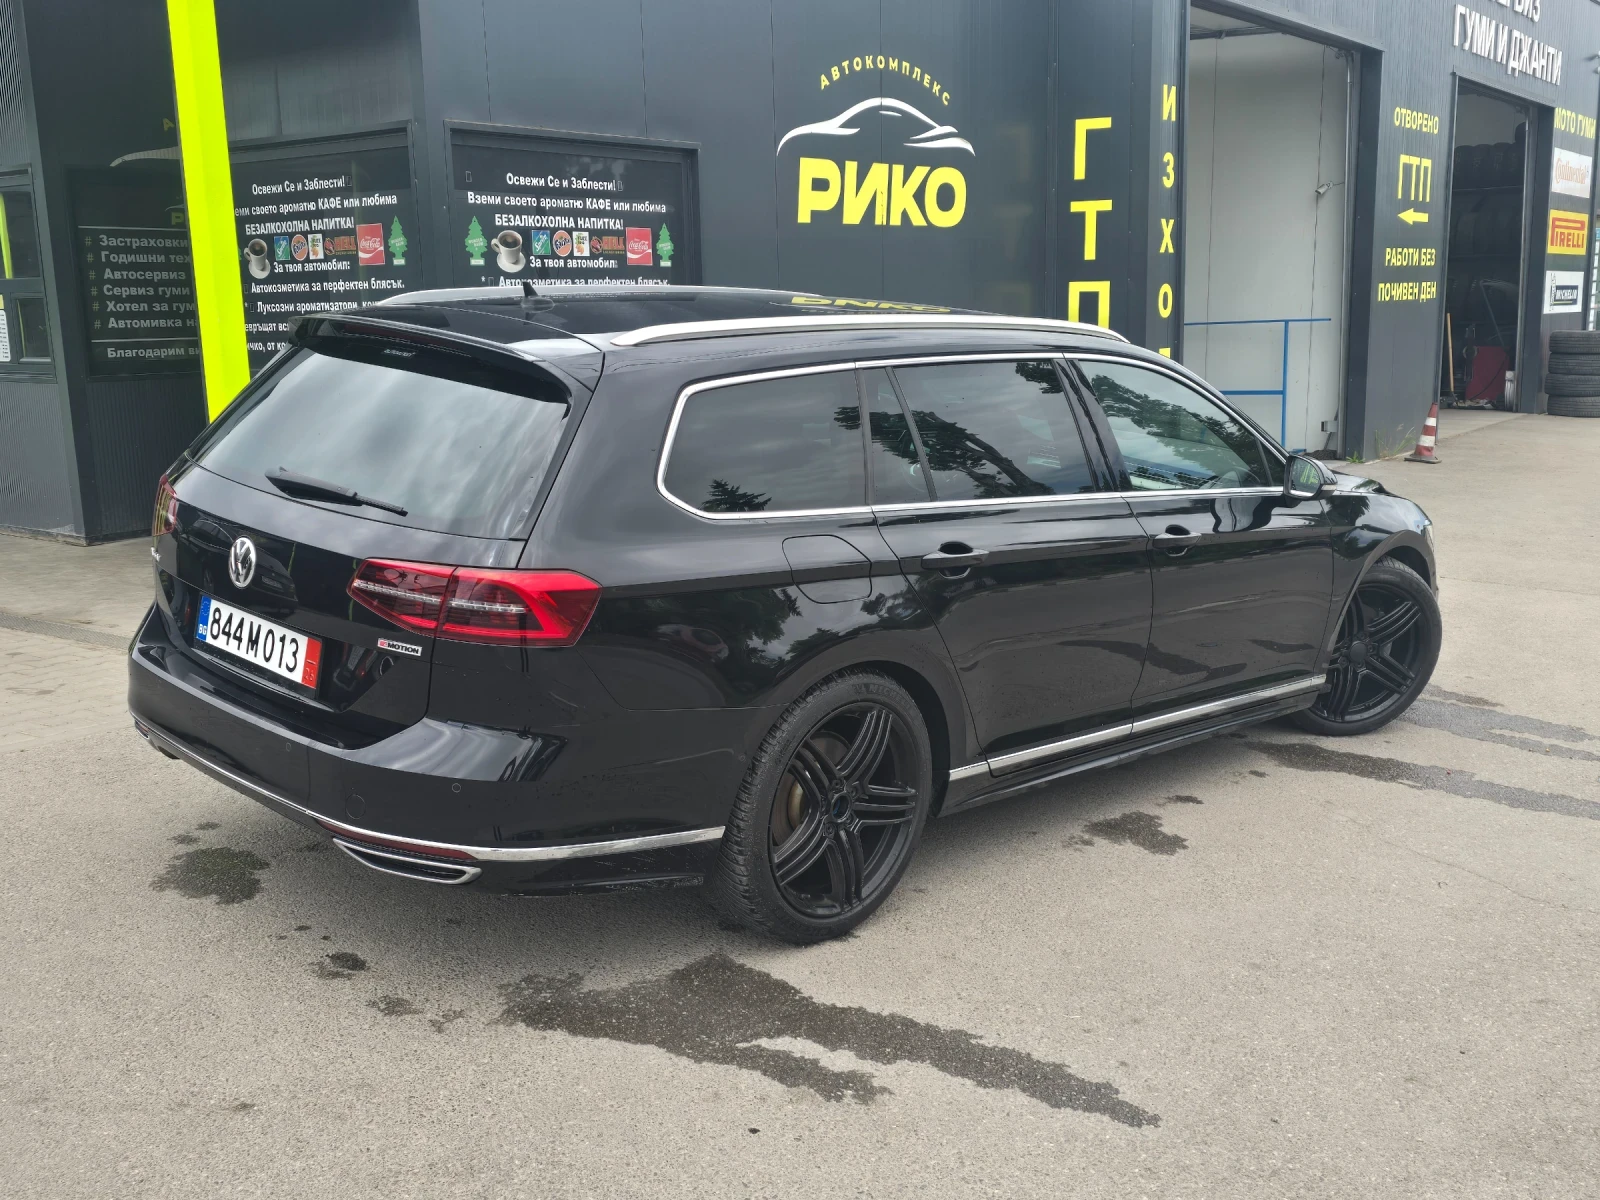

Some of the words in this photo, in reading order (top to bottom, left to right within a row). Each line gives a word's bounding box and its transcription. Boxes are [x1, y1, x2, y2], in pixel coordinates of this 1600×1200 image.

[1453, 4, 1496, 60] ГУМИ
[1496, 23, 1508, 65] И
[1507, 28, 1562, 86] ДЖАНТИ
[819, 55, 951, 106] АВТОКОМПЛЕКС
[1394, 106, 1439, 134] ОТВОРЕНО
[1554, 107, 1576, 134] МОТО
[1577, 113, 1596, 139] ГУМИ
[252, 182, 283, 195] Освежи
[284, 180, 295, 192] Се
[297, 182, 302, 191] и
[304, 175, 345, 190] Заблести!
[506, 172, 545, 186] Освежи
[547, 175, 560, 188] Се
[562, 179, 569, 188] и
[571, 177, 616, 191] Заблести!
[1398, 154, 1432, 202] ГТП
[797, 157, 967, 228] РИКО
[235, 206, 250, 217] еми
[252, 204, 277, 215] своето
[279, 201, 316, 215] ароматно
[318, 197, 342, 210] КАФЕ
[343, 199, 359, 208] или
[362, 193, 397, 207] любима
[467, 191, 501, 205] Вземи
[504, 195, 537, 206] своето
[540, 198, 583, 210] ароматно
[586, 198, 611, 211] КАФЕ
[613, 201, 630, 211] или
[632, 200, 666, 213] любима
[245, 218, 310, 235] БЕЗАЛКОХОЛНА
[311, 216, 354, 231] НАПИТКА!
[495, 213, 575, 229] БЕЗАЛКОХОЛНА
[577, 216, 624, 231] НАПИТКА!
[1068, 117, 1113, 330] ГТП
[1158, 84, 1177, 358] ИЗХО
[99, 234, 188, 249] Застраховки
[1550, 217, 1586, 249] PIRELLI
[334, 236, 356, 250] HELL
[602, 236, 625, 250] HELL
[100, 251, 166, 264] Годишни
[529, 256, 542, 268] За
[544, 259, 564, 268] твоя
[567, 256, 618, 270] автомобил:
[1385, 247, 1419, 266] РАБОТИ
[1421, 248, 1436, 266] БЕЗ
[104, 268, 186, 282] Автосервиз
[274, 262, 284, 273] За
[285, 263, 302, 272] твоя
[304, 259, 350, 271] автомобил:
[251, 281, 310, 293] Автокозметика
[312, 282, 321, 290] за
[323, 279, 369, 293] перфектен
[371, 277, 405, 290] блясък.
[499, 276, 573, 286] Автоозметика
[103, 284, 154, 298] Сервиз
[158, 286, 190, 297] гуми
[1378, 282, 1419, 302] ПОЧИВЕН
[1420, 281, 1437, 303] ДЕН
[106, 301, 148, 312] Хотел
[152, 302, 168, 311] за
[172, 303, 197, 313] гум
[257, 301, 294, 315] Луксозни
[108, 317, 182, 329] Автомивка
[244, 322, 277, 334] евръщат
[107, 347, 185, 359] Благодарим
[267, 342, 275, 350] от
